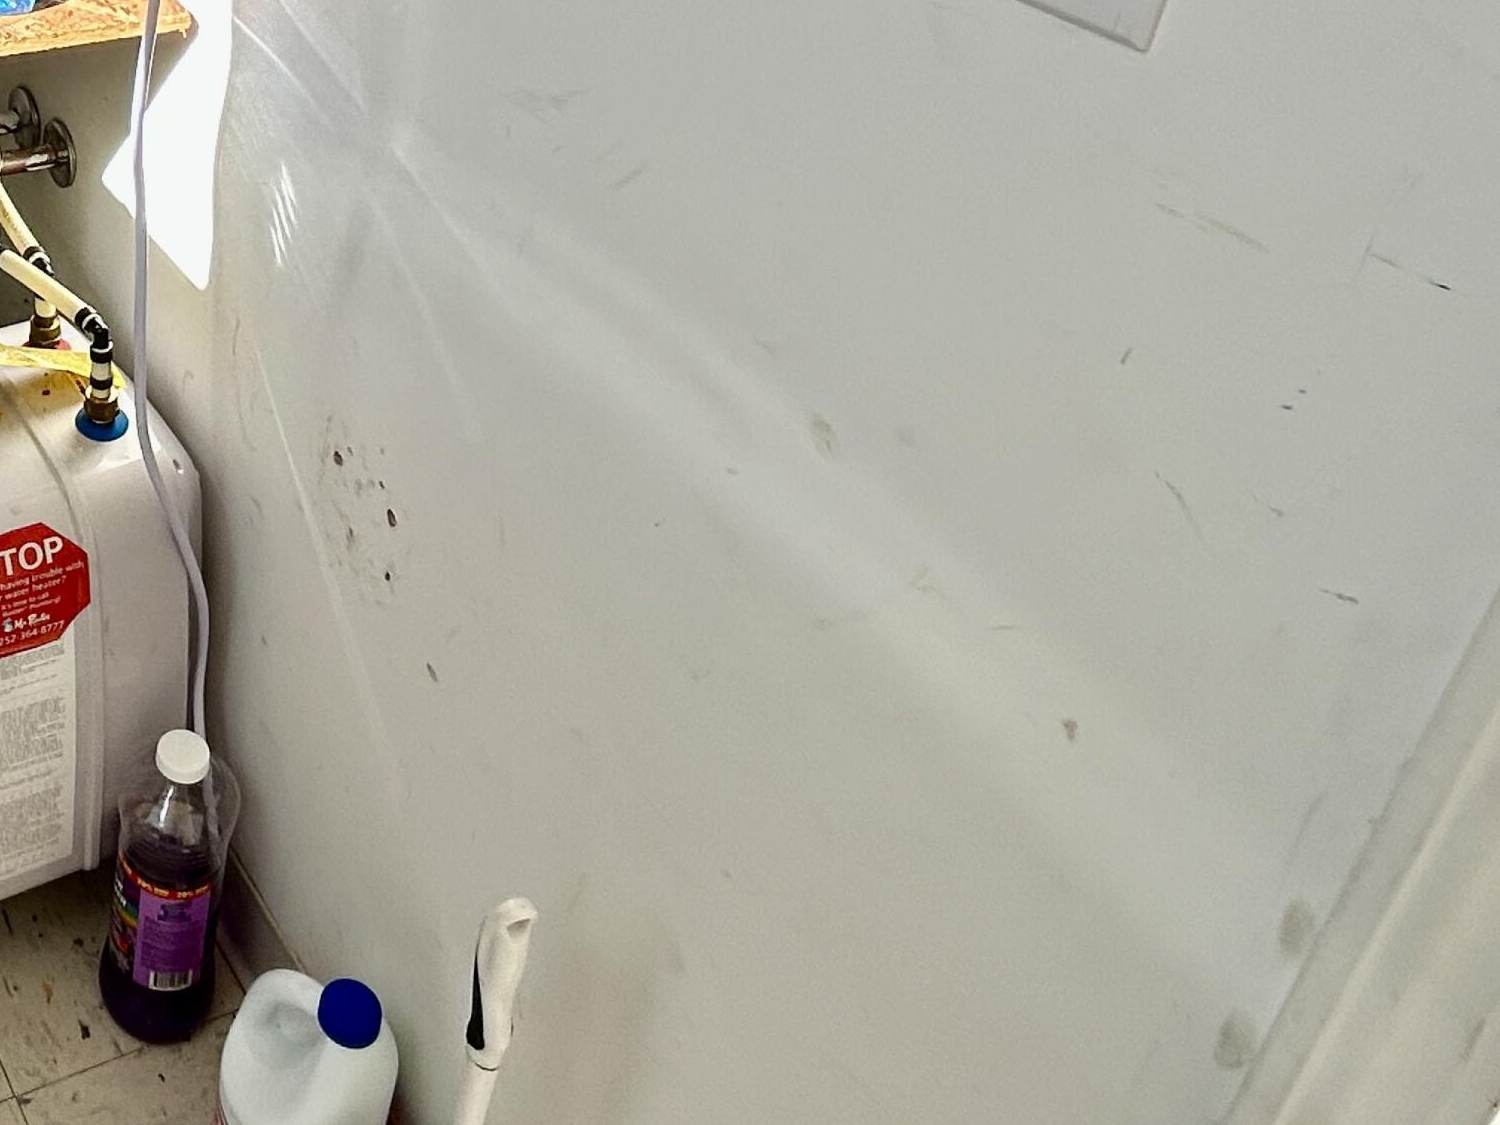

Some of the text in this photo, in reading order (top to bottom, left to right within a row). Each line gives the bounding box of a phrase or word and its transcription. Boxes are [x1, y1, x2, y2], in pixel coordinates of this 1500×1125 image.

[0, 577, 30, 591] having
[31, 567, 63, 582] trouble
[65, 559, 84, 572] with
[5, 588, 30, 600] water
[32, 575, 67, 592] heater?
